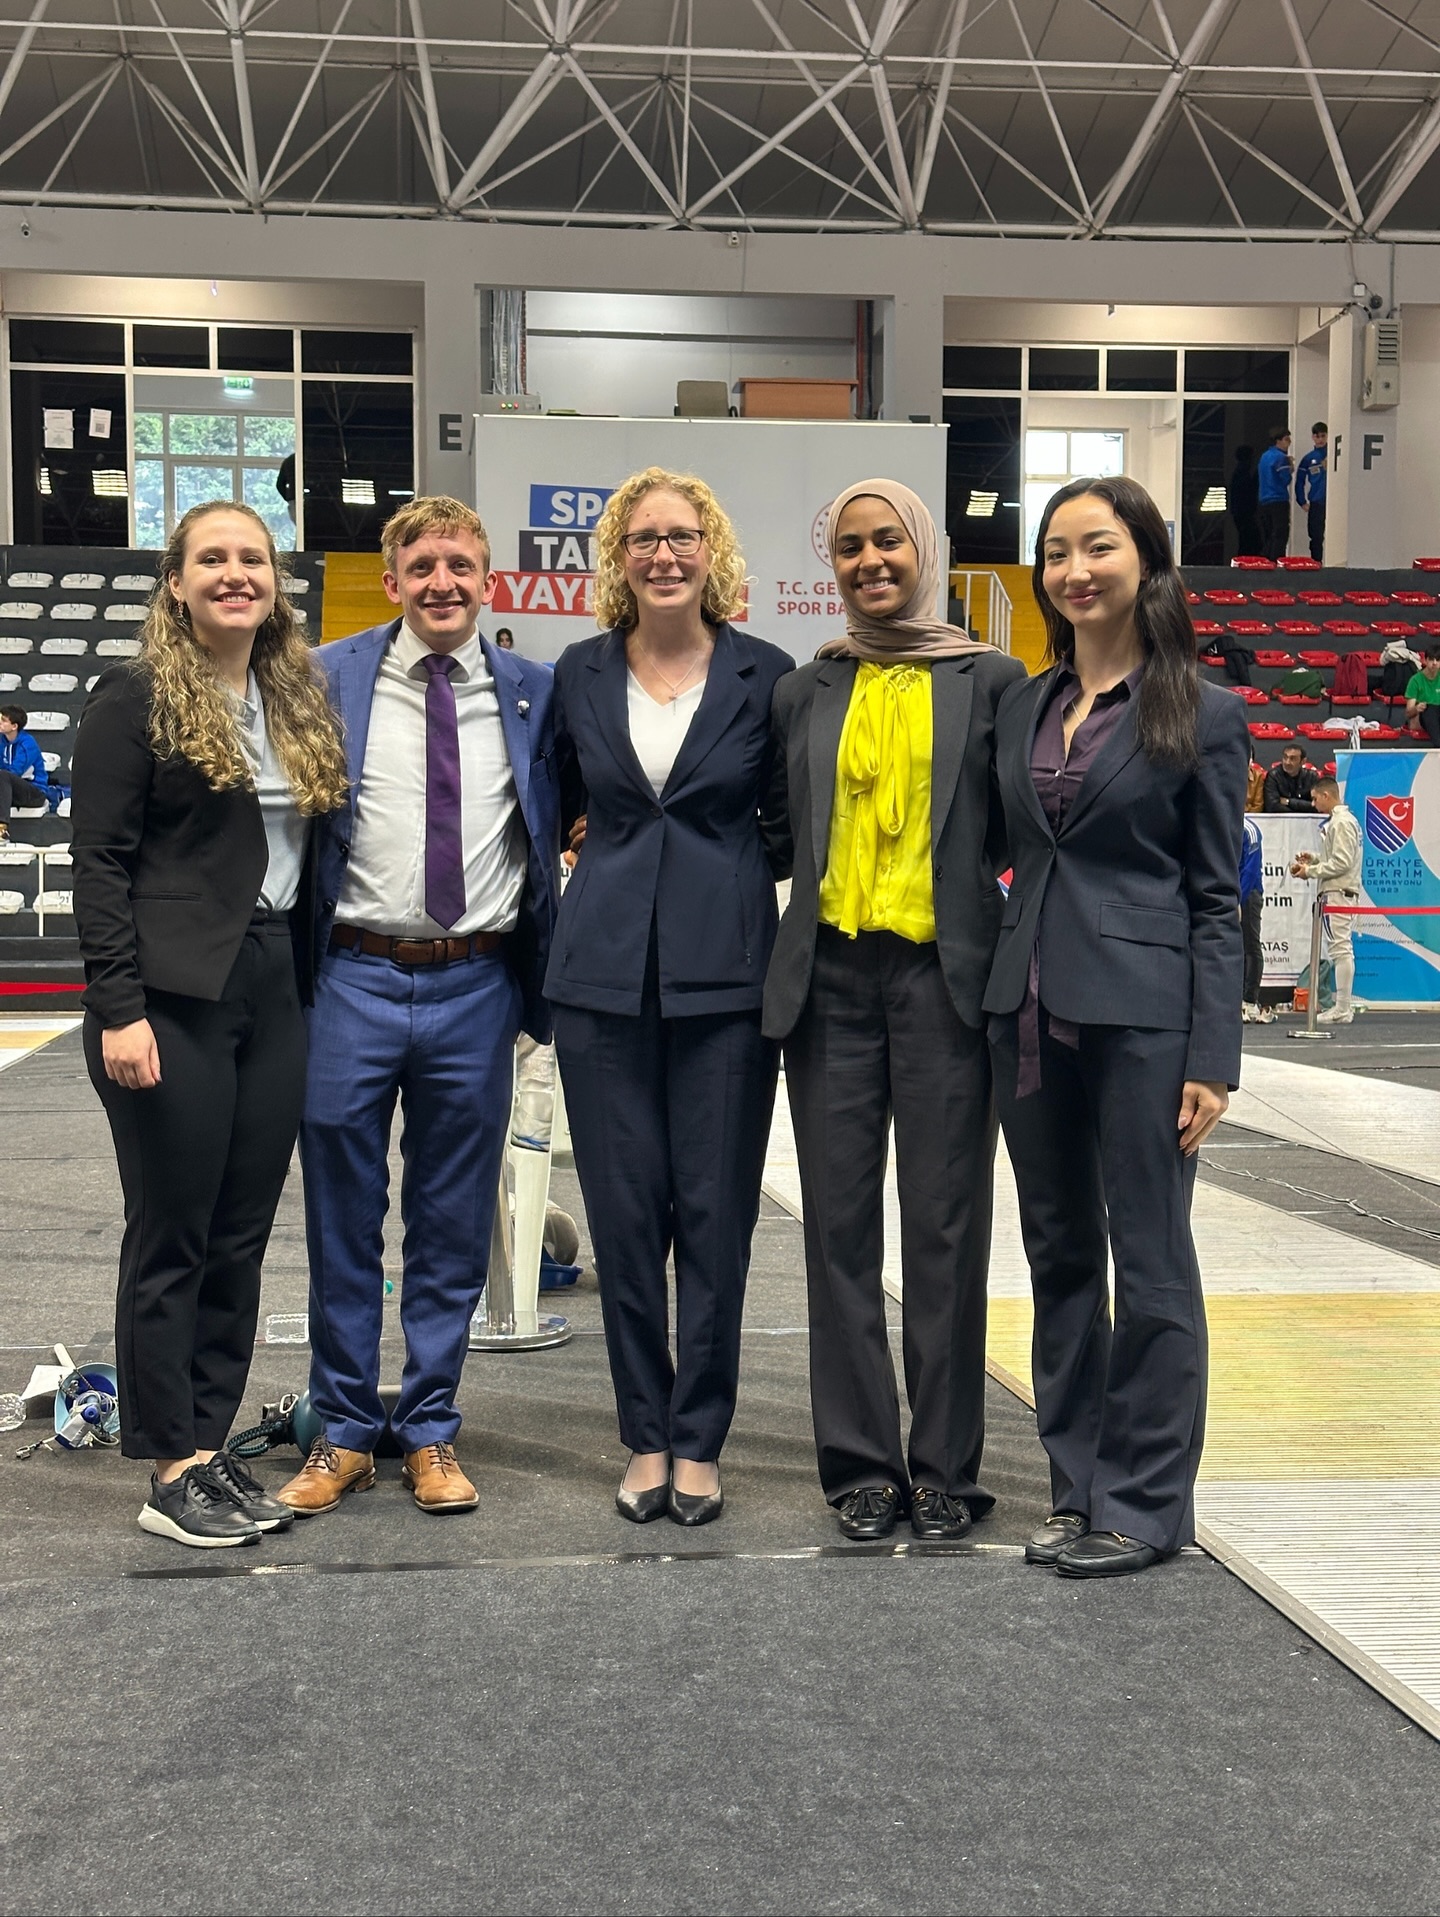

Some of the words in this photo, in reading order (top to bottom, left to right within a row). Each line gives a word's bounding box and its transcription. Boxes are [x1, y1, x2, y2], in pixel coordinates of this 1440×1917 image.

[439, 413, 462, 451] E
[1334, 434, 1342, 472] F
[1363, 434, 1384, 470] F
[777, 581, 808, 595] T.C.
[813, 582, 842, 595] GE
[777, 601, 821, 615] SPOR
[1265, 893, 1293, 907] rim
[1261, 941, 1289, 953] ATAŞ
